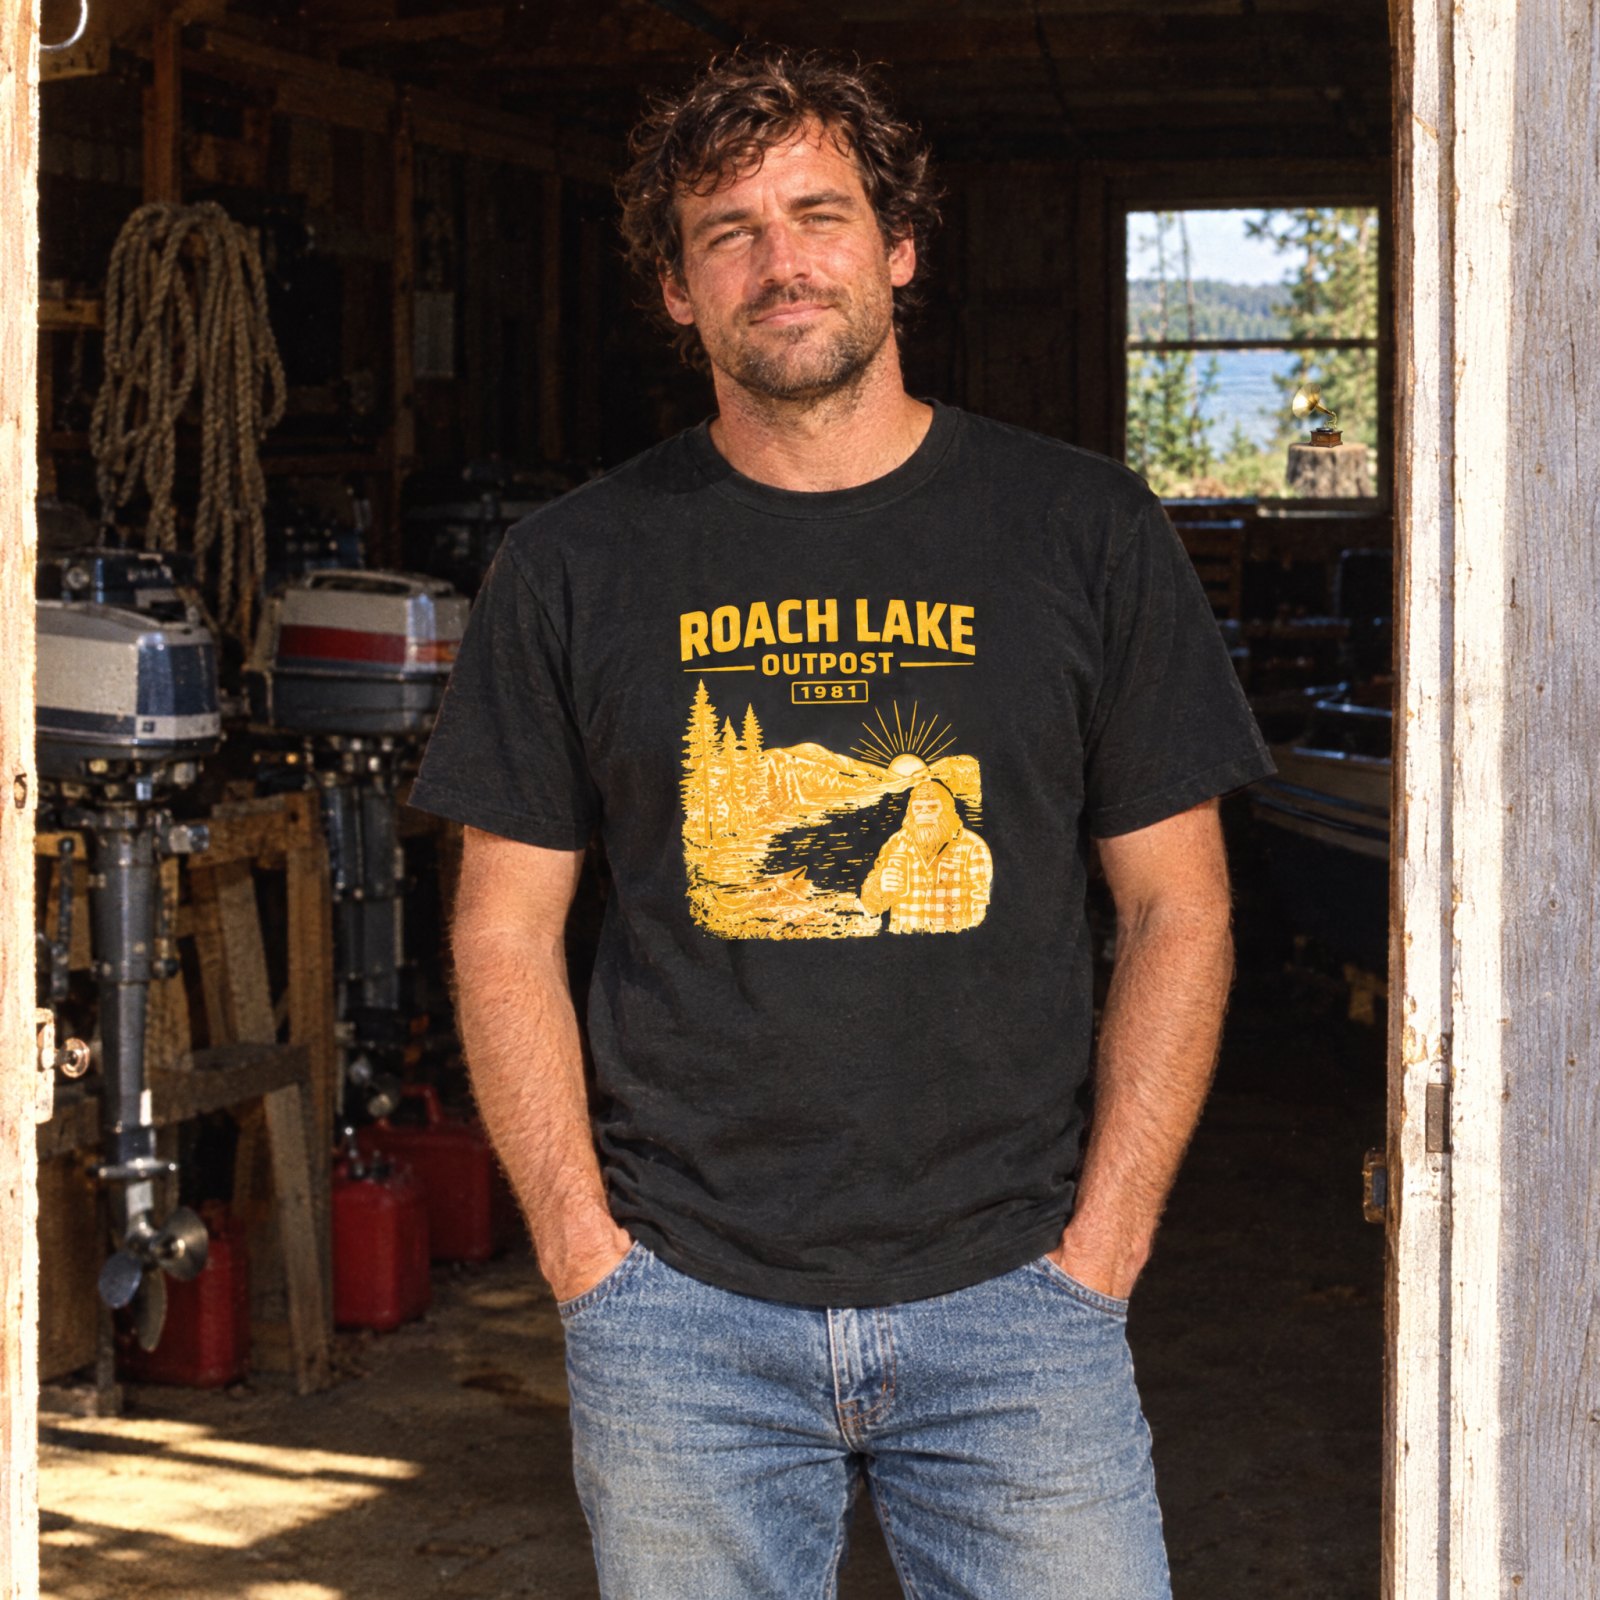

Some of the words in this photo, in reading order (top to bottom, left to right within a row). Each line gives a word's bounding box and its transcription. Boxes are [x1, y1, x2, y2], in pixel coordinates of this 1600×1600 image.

[680, 599, 838, 662] ROACH
[856, 598, 976, 655] LAKE
[761, 652, 894, 676] OUTPOST
[800, 685, 858, 699] 1981
